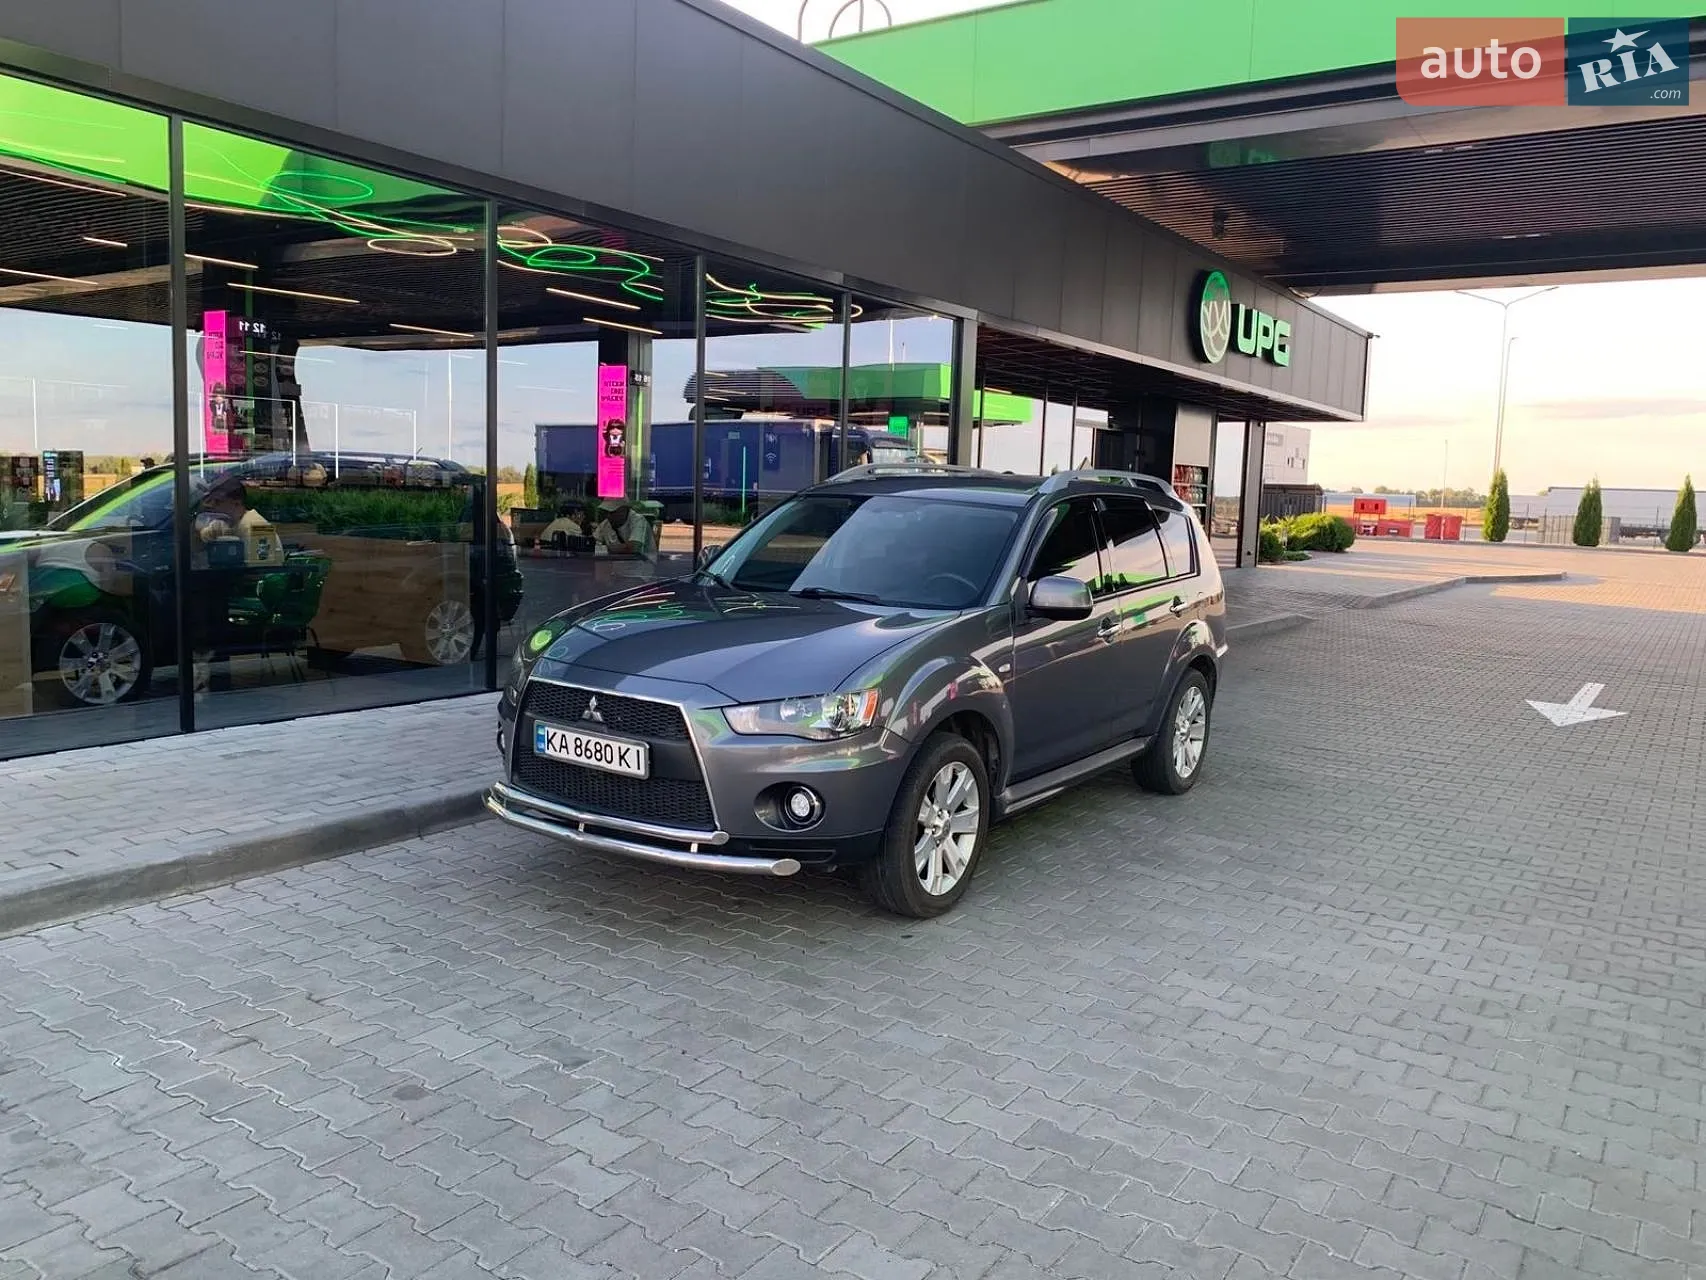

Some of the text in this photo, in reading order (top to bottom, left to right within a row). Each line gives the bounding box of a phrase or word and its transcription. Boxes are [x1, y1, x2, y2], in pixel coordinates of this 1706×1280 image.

[1237, 303, 1292, 367] UPG
[546, 730, 641, 770] KA 8680 KI
